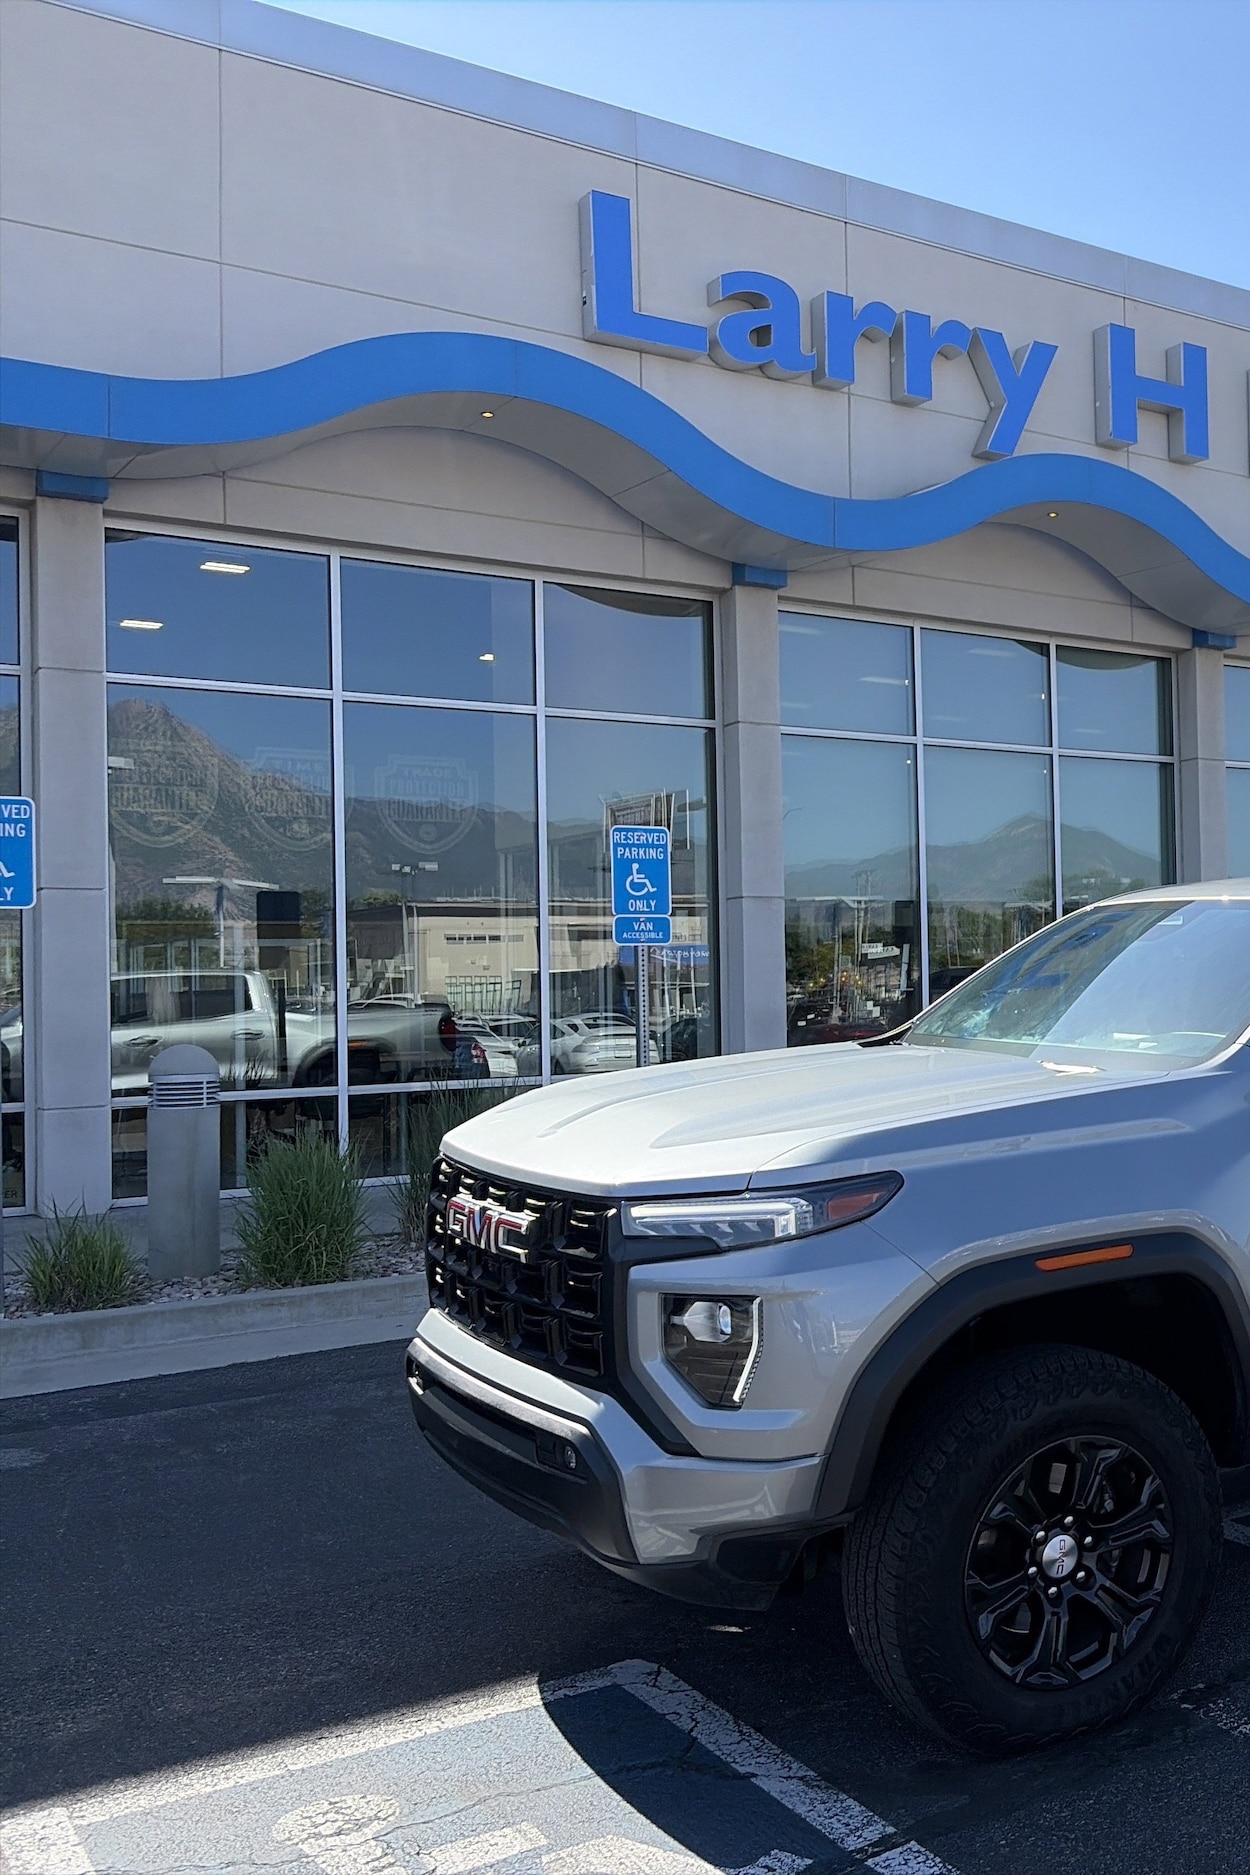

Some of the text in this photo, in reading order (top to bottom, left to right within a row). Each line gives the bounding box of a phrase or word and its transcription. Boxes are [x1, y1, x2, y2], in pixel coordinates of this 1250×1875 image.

[579, 190, 1059, 460] Larry
[1094, 322, 1209, 465] H
[613, 831, 667, 845] RESERVED
[617, 847, 664, 860] PARKING
[628, 899, 657, 912] ONLY
[633, 921, 654, 931] VAN
[622, 931, 664, 939] ACCESSIBLE
[446, 1196, 530, 1264] GMC
[1056, 1538, 1067, 1575] GMC
